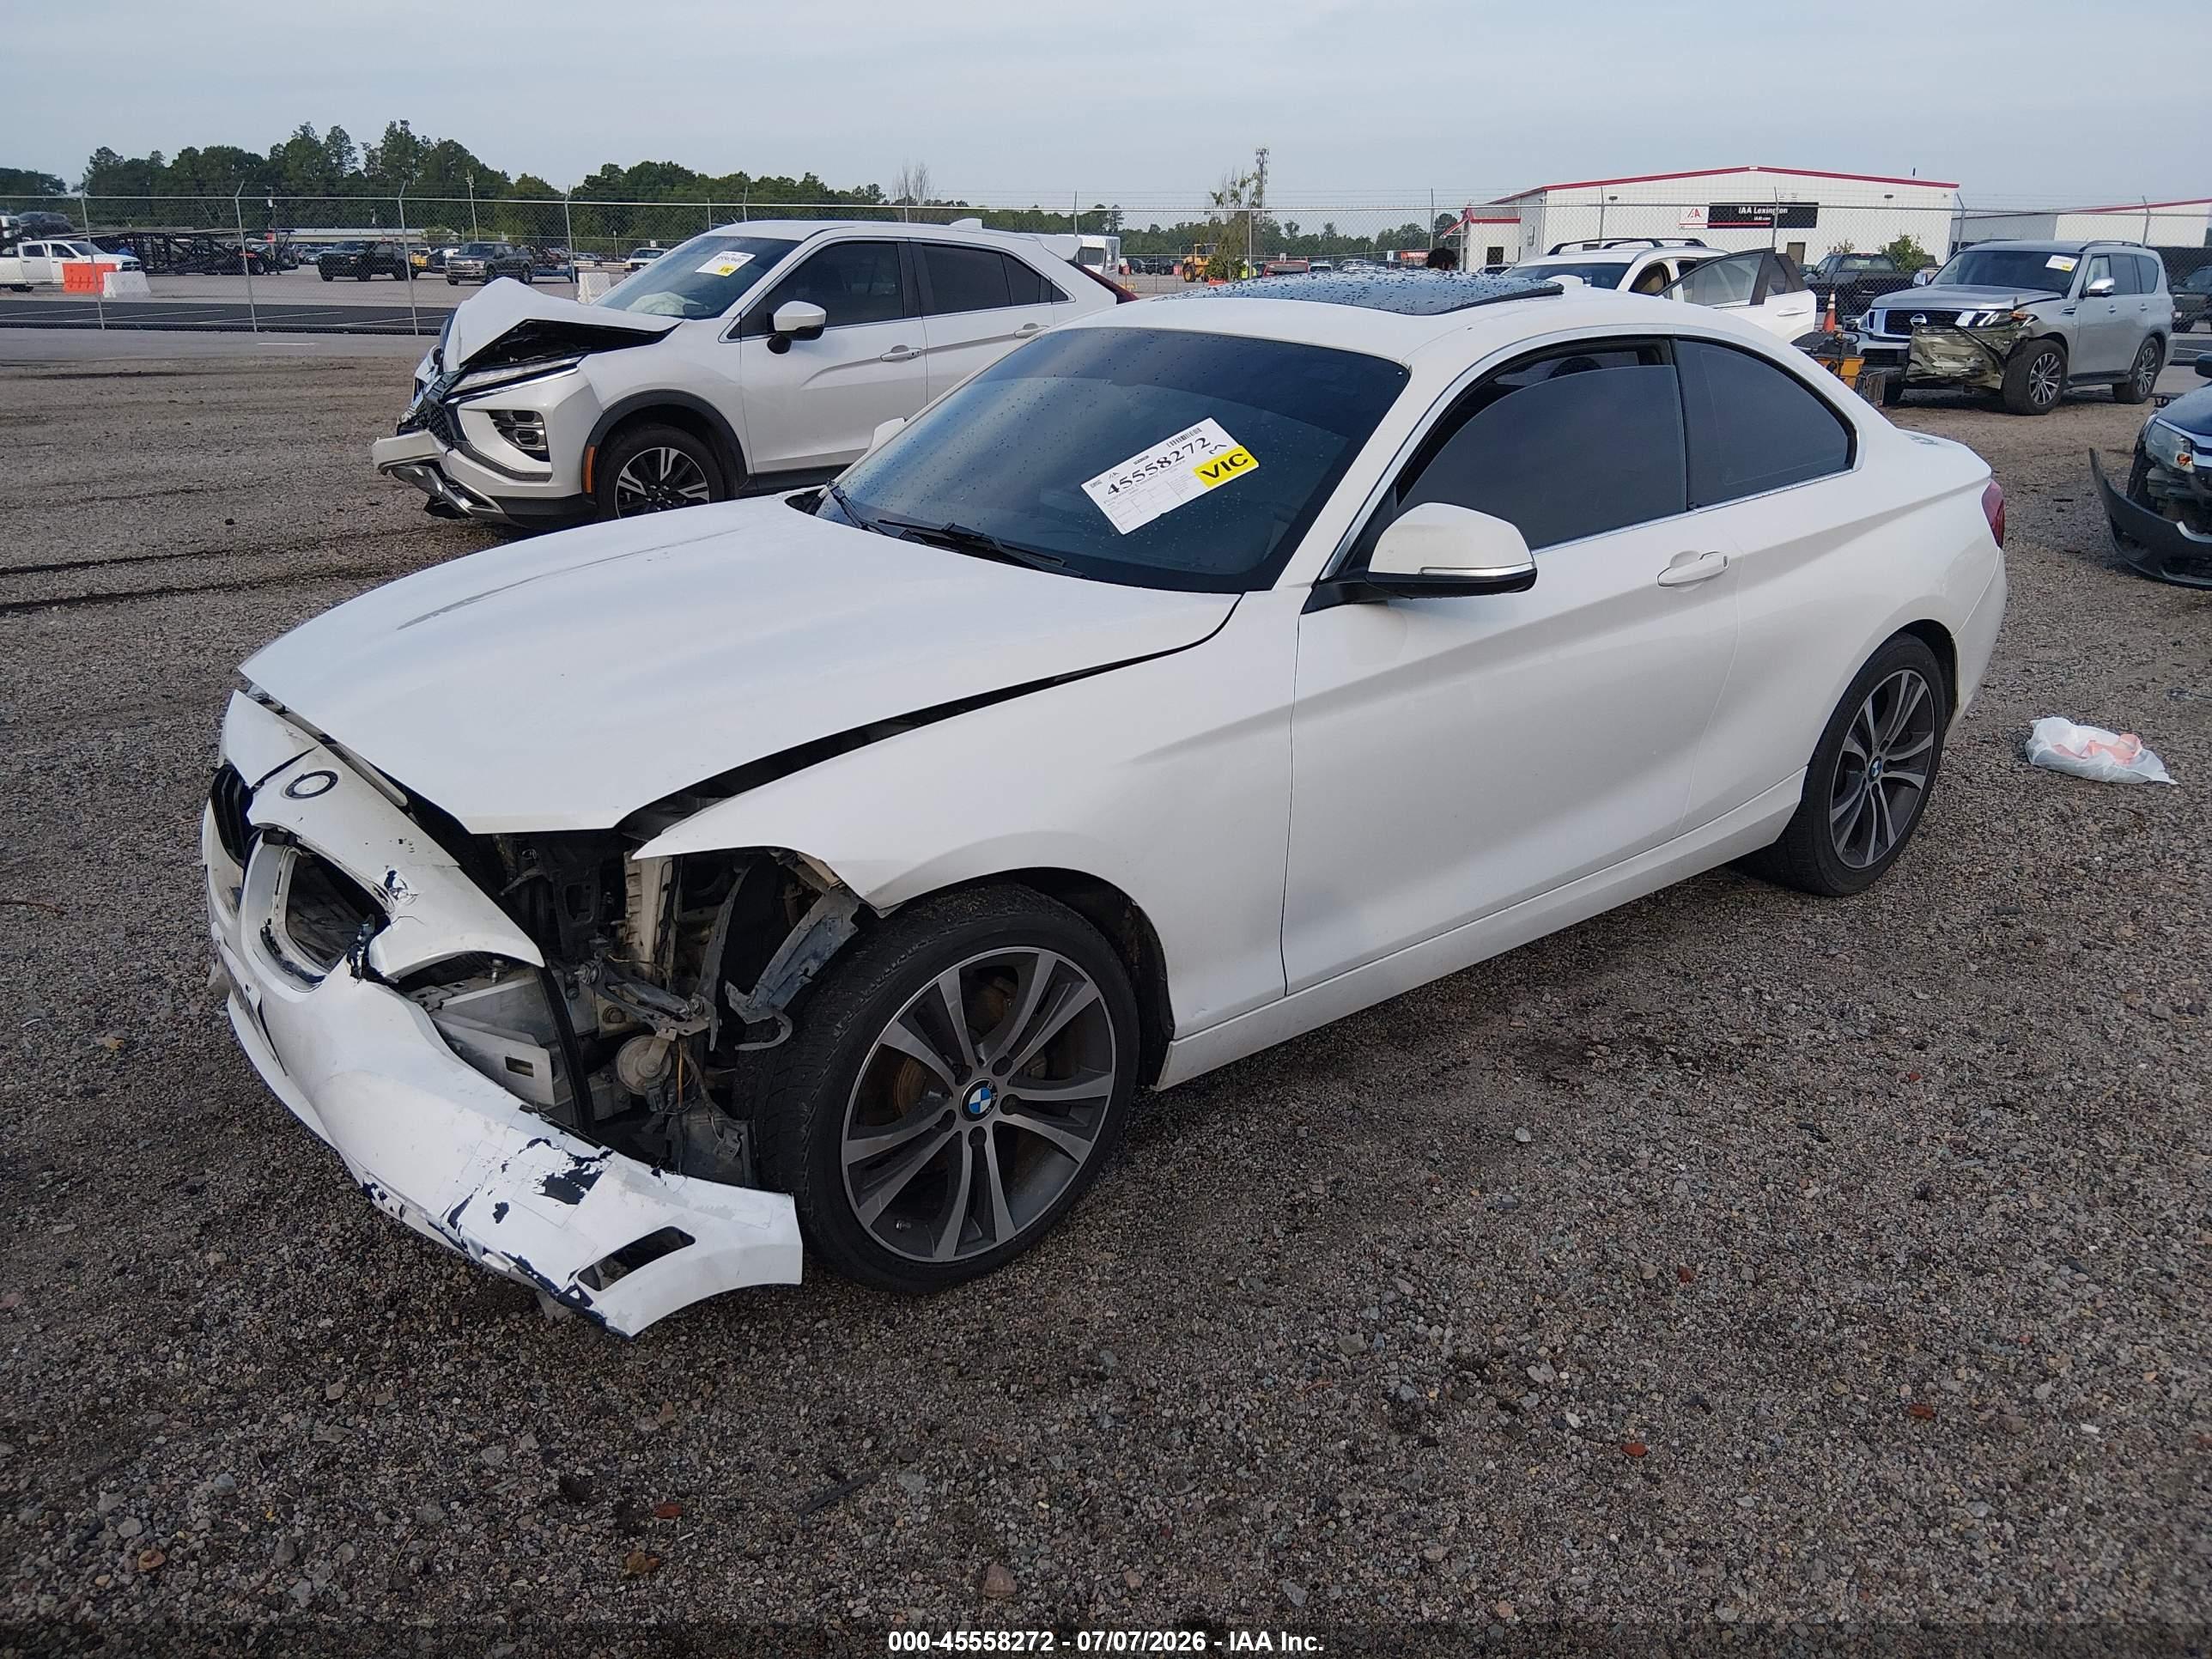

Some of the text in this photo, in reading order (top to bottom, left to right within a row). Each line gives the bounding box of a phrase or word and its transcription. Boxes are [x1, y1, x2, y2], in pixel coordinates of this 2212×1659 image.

[1738, 206, 1788, 216] IAA Lexingon
[1107, 437, 1211, 495] 45558272
[1200, 453, 1249, 478] VIC
